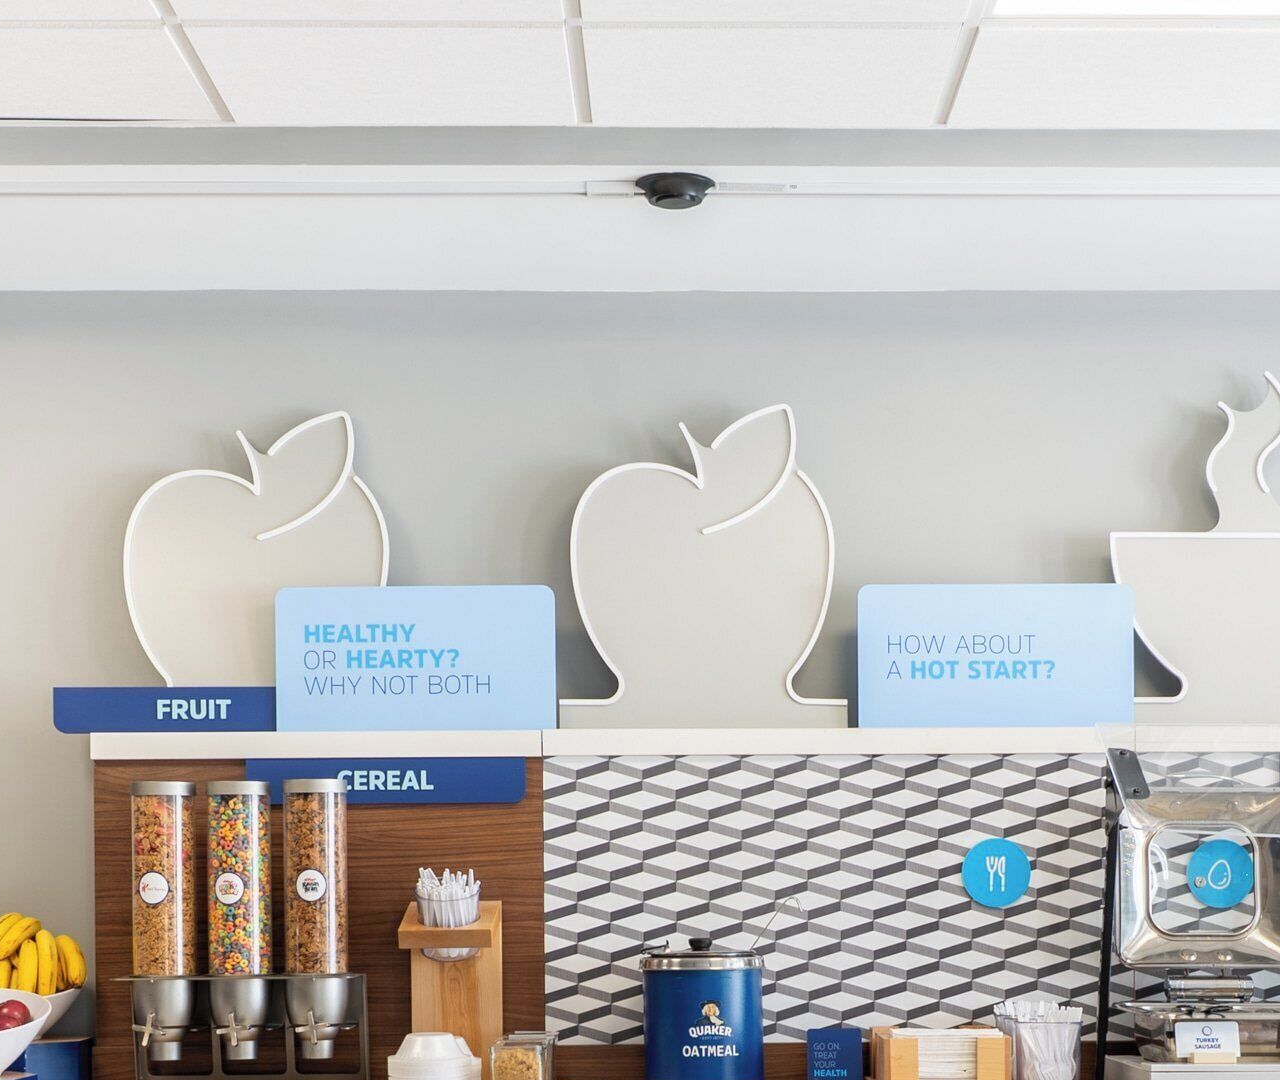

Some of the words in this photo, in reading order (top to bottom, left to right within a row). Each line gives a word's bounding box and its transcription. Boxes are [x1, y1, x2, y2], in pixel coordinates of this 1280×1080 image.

[303, 623, 416, 643] HEALTHY
[886, 634, 946, 654] HOW
[955, 634, 1036, 654] ABOUT
[303, 650, 337, 670] OR
[346, 648, 460, 669] HEARTY?
[886, 660, 902, 680] A
[910, 660, 959, 680] HOT
[967, 660, 1056, 680] START?
[303, 676, 362, 696] WHY
[371, 675, 419, 695] NOT
[428, 674, 491, 695] BOTH
[156, 699, 232, 720] FRUIT
[336, 769, 435, 791] CEREAL
[688, 1025, 733, 1038] QUAKER
[682, 1044, 740, 1057] OATMEAL
[813, 1042, 826, 1051] GO
[813, 1051, 838, 1060] TREAT
[813, 1060, 836, 1069] YOUR
[813, 1069, 848, 1077] HEALTH
